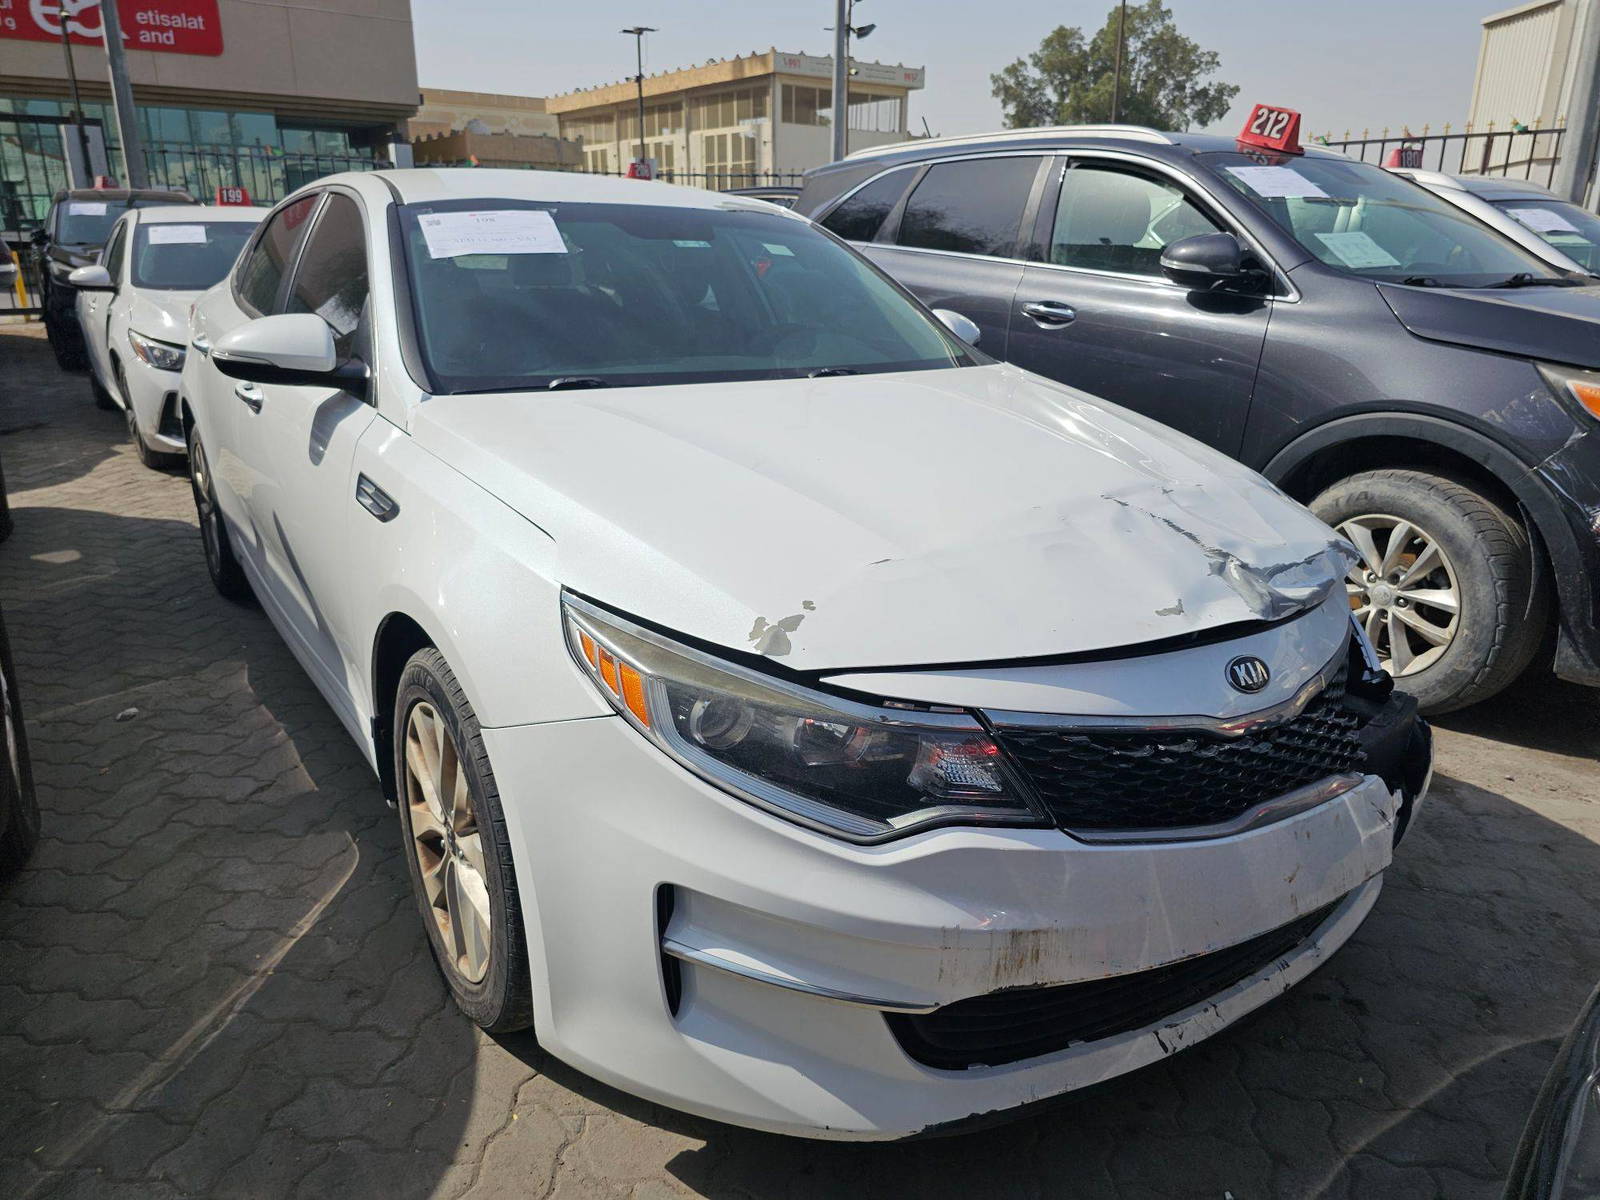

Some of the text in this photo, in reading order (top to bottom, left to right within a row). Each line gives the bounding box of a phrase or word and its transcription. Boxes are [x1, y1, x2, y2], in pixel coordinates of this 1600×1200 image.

[136, 10, 206, 30] etisalat
[139, 30, 175, 45] and
[1250, 107, 1290, 139] 212
[1402, 150, 1420, 167] 180
[222, 188, 243, 203] 199
[1232, 660, 1269, 687] KIA
